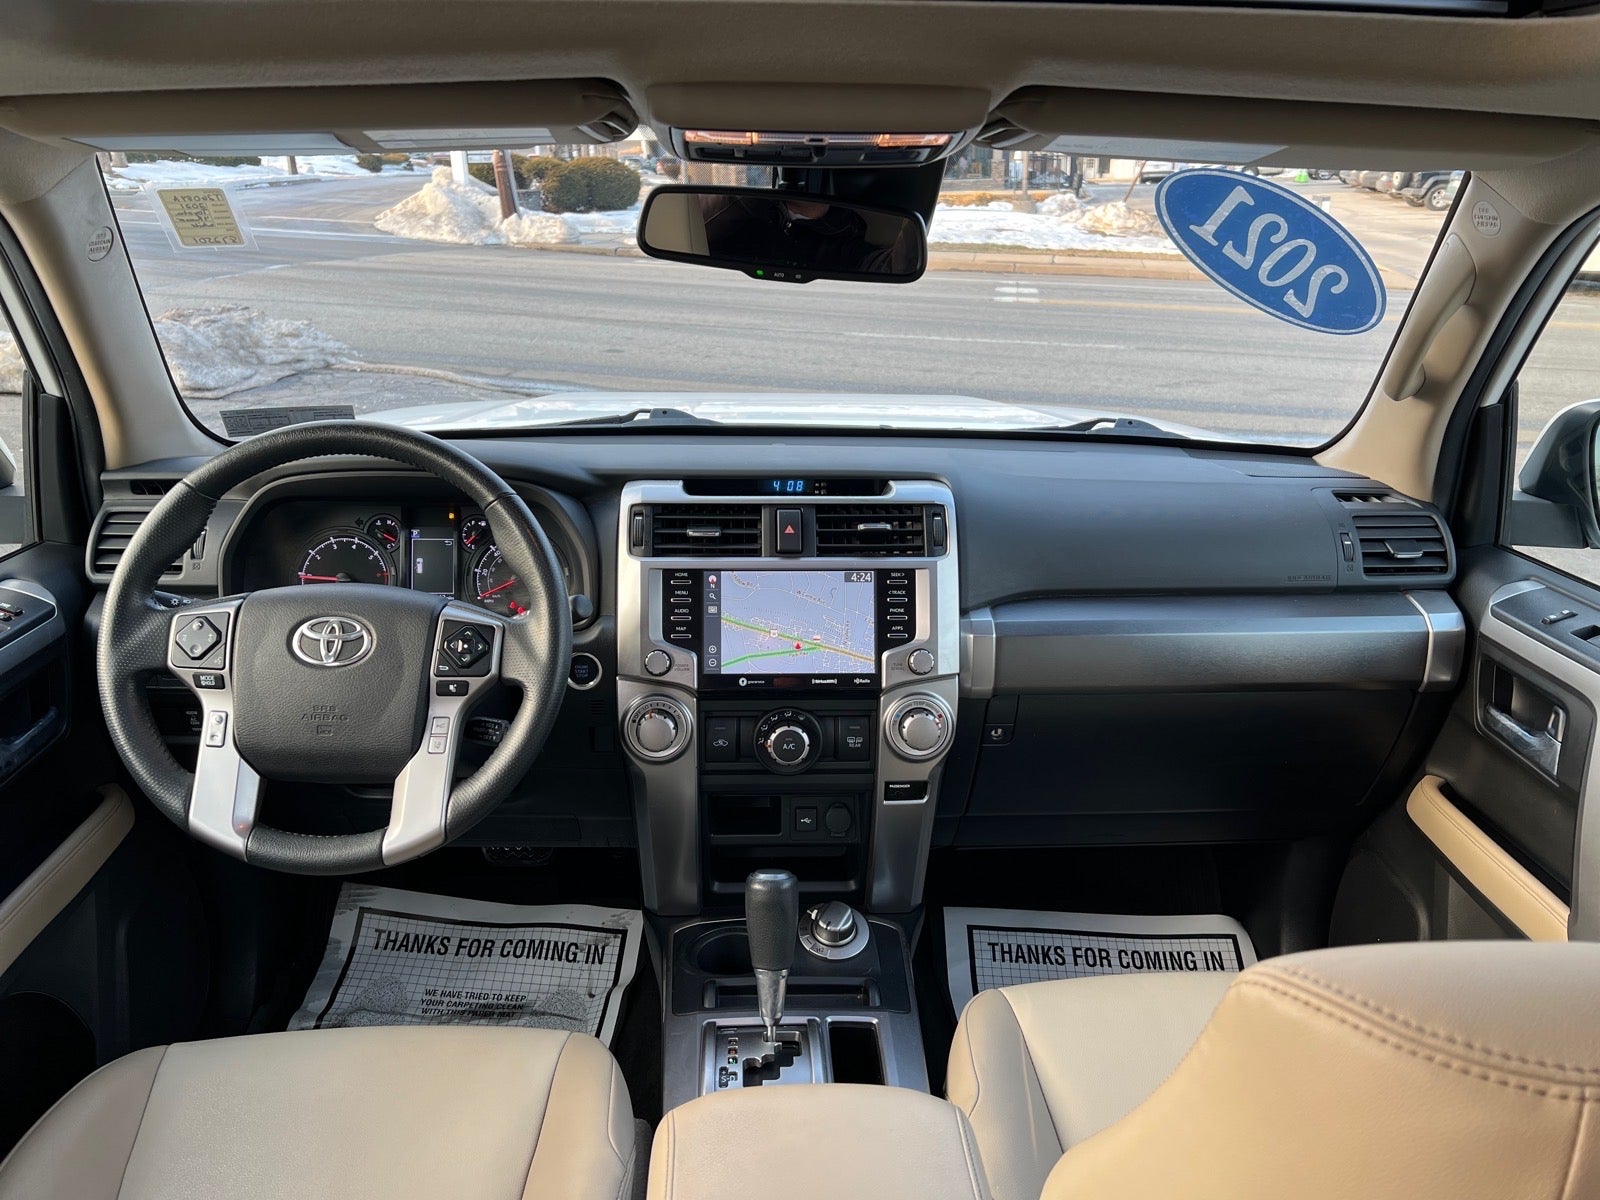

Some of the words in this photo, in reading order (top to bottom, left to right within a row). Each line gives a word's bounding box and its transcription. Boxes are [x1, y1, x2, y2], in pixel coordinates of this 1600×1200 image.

[482, 568, 488, 576] 20
[851, 573, 871, 581] 4:24
[301, 713, 349, 721] AIRBAG
[374, 928, 450, 956] THANKS
[455, 938, 495, 958] FOR
[500, 938, 579, 963] COMING
[585, 942, 606, 965] IN
[988, 942, 1065, 967] THANKS
[1073, 947, 1112, 968] FOR
[1118, 949, 1197, 971] COMING
[1203, 951, 1226, 971] IN
[425, 988, 439, 997] WE
[440, 990, 462, 999] HAVE
[465, 991, 489, 1001] TRIED
[492, 993, 502, 1001] TO
[504, 994, 527, 1002] KEEP
[420, 998, 445, 1007] YOUR
[446, 1000, 494, 1009] CARPETING
[421, 1007, 443, 1015] WITH
